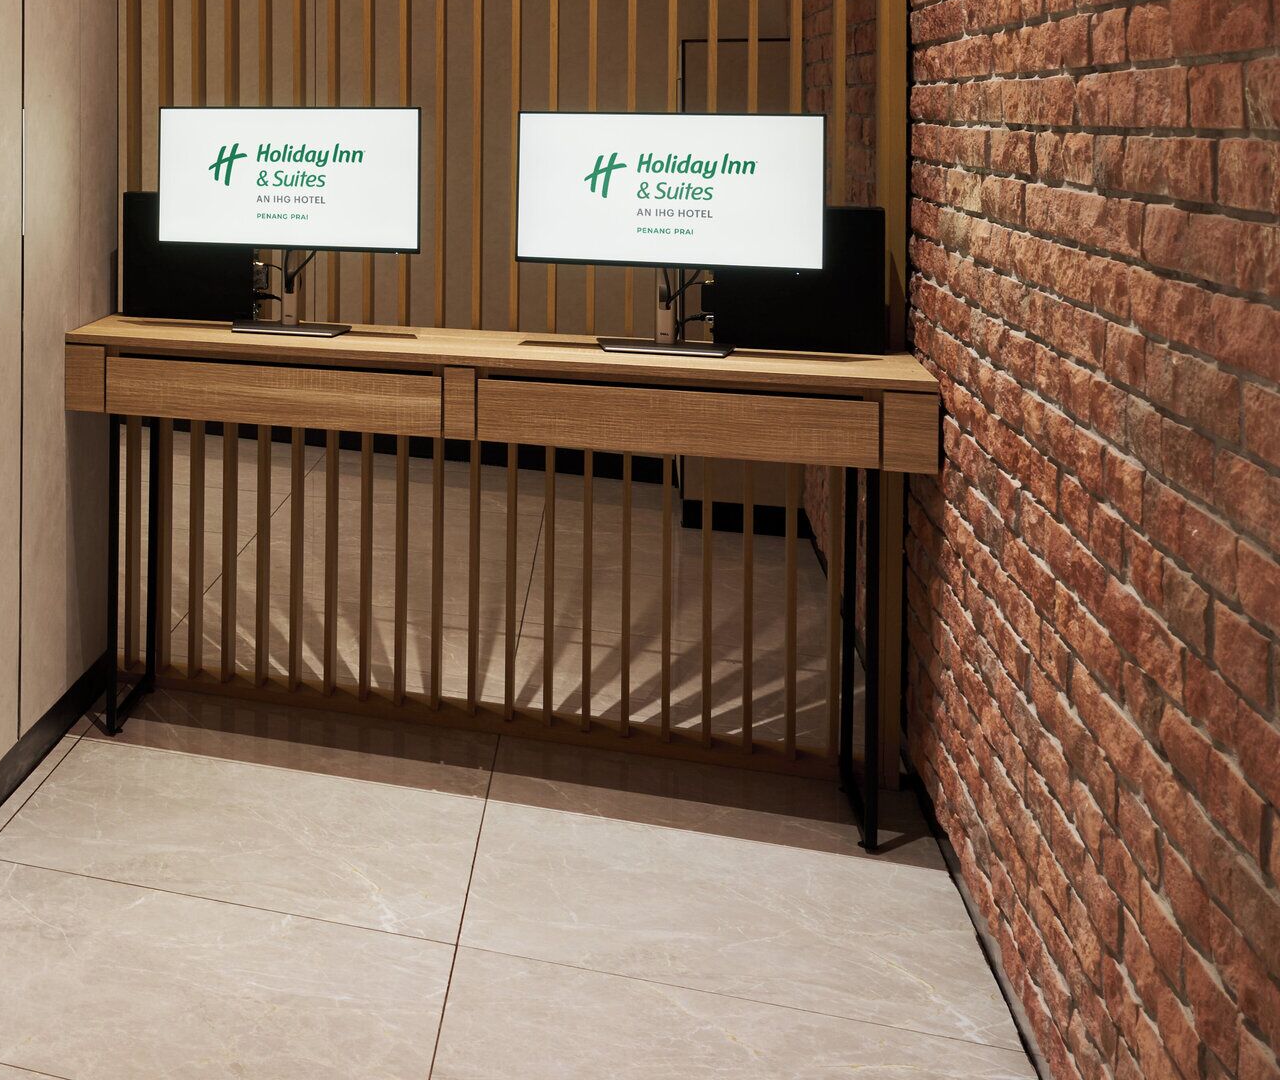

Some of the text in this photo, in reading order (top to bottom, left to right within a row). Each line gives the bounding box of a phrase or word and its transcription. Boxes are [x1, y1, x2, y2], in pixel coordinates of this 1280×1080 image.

[256, 142, 363, 167] Holiday Inn
[636, 152, 756, 179] Holiday Inn
[256, 169, 327, 188] & Suites
[636, 181, 714, 201] & Suites
[256, 195, 326, 205] AN IHG HOTEL
[256, 212, 309, 221] PENANG PRAI
[636, 208, 713, 219] AN IHG HOTEL
[636, 227, 694, 236] PENANG PRAI
